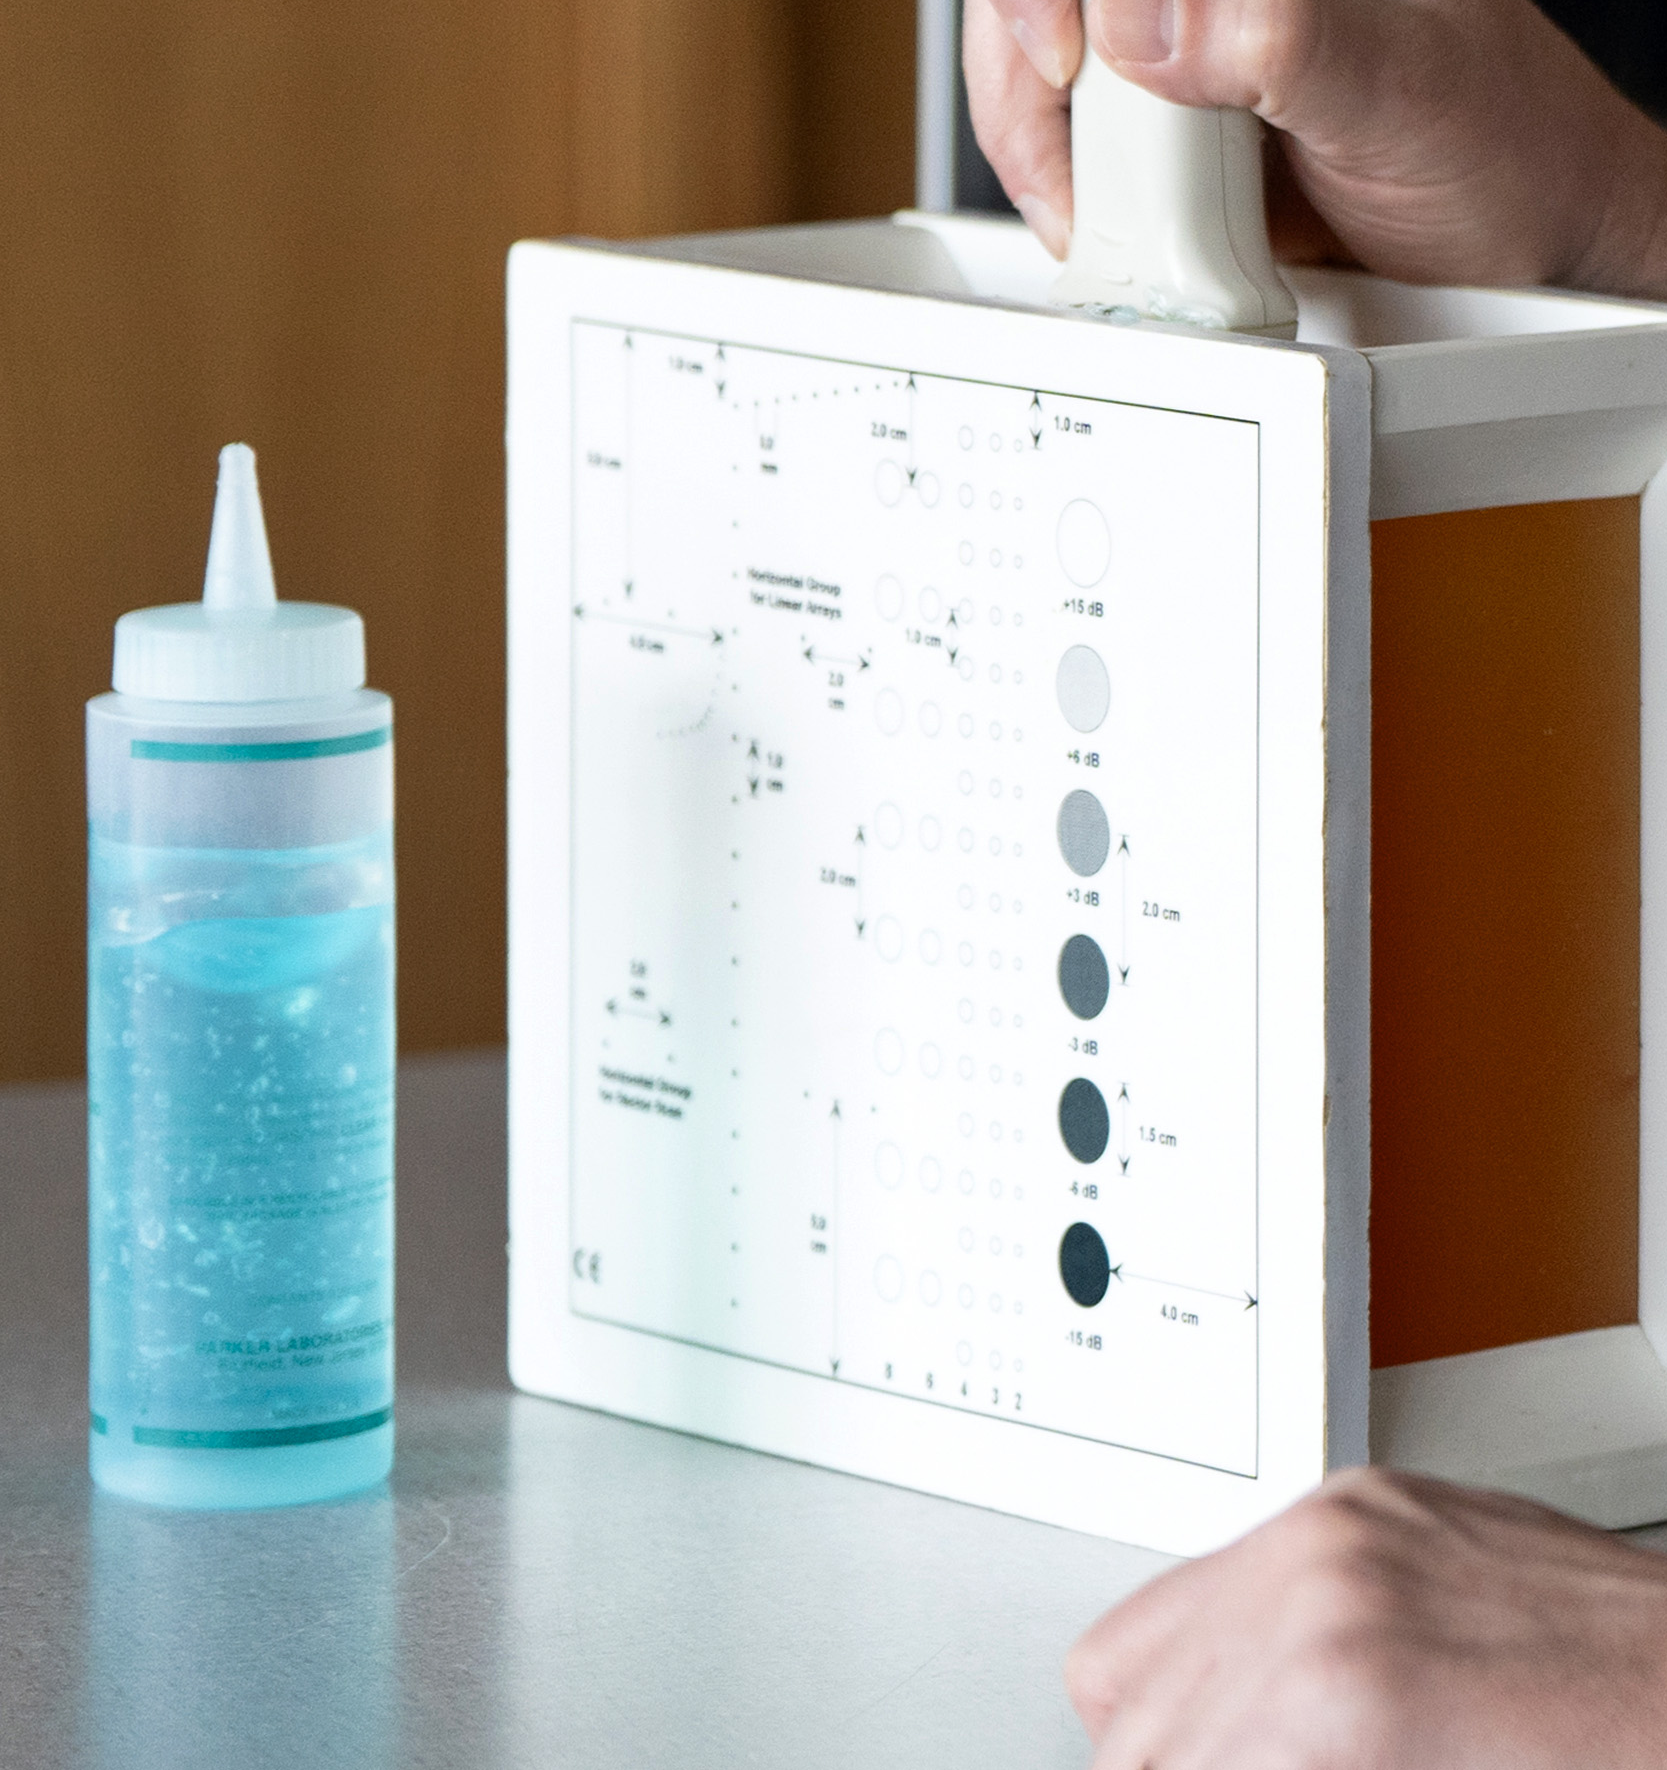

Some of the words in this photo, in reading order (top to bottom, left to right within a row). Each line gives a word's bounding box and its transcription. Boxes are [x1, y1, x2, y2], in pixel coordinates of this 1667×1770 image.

[889, 427, 908, 441] cm
[1054, 415, 1071, 432] 1.0
[1073, 420, 1093, 435] cm
[748, 566, 804, 590] Horizontal
[806, 576, 842, 598] Group
[767, 591, 803, 612] Linear
[806, 600, 843, 620] Arrays
[1063, 597, 1085, 614] +15
[1087, 601, 1105, 618] dB
[905, 628, 922, 645] 1.0
[924, 634, 942, 648] cm
[1066, 749, 1081, 765] +6
[1083, 752, 1101, 769] dB
[1066, 887, 1081, 904] +3
[1083, 891, 1101, 908] dB
[1142, 900, 1160, 918] 2.0
[1162, 906, 1181, 922] cm
[1067, 1036, 1079, 1053] -3
[1082, 1039, 1099, 1056] dB
[1139, 1125, 1157, 1143] 1.5
[1159, 1129, 1178, 1147] cm
[1082, 1184, 1099, 1201] dB
[1159, 1303, 1178, 1322] 4.0
[1180, 1308, 1200, 1327] cm
[1064, 1330, 1084, 1347] -15
[1086, 1333, 1103, 1351] dB
